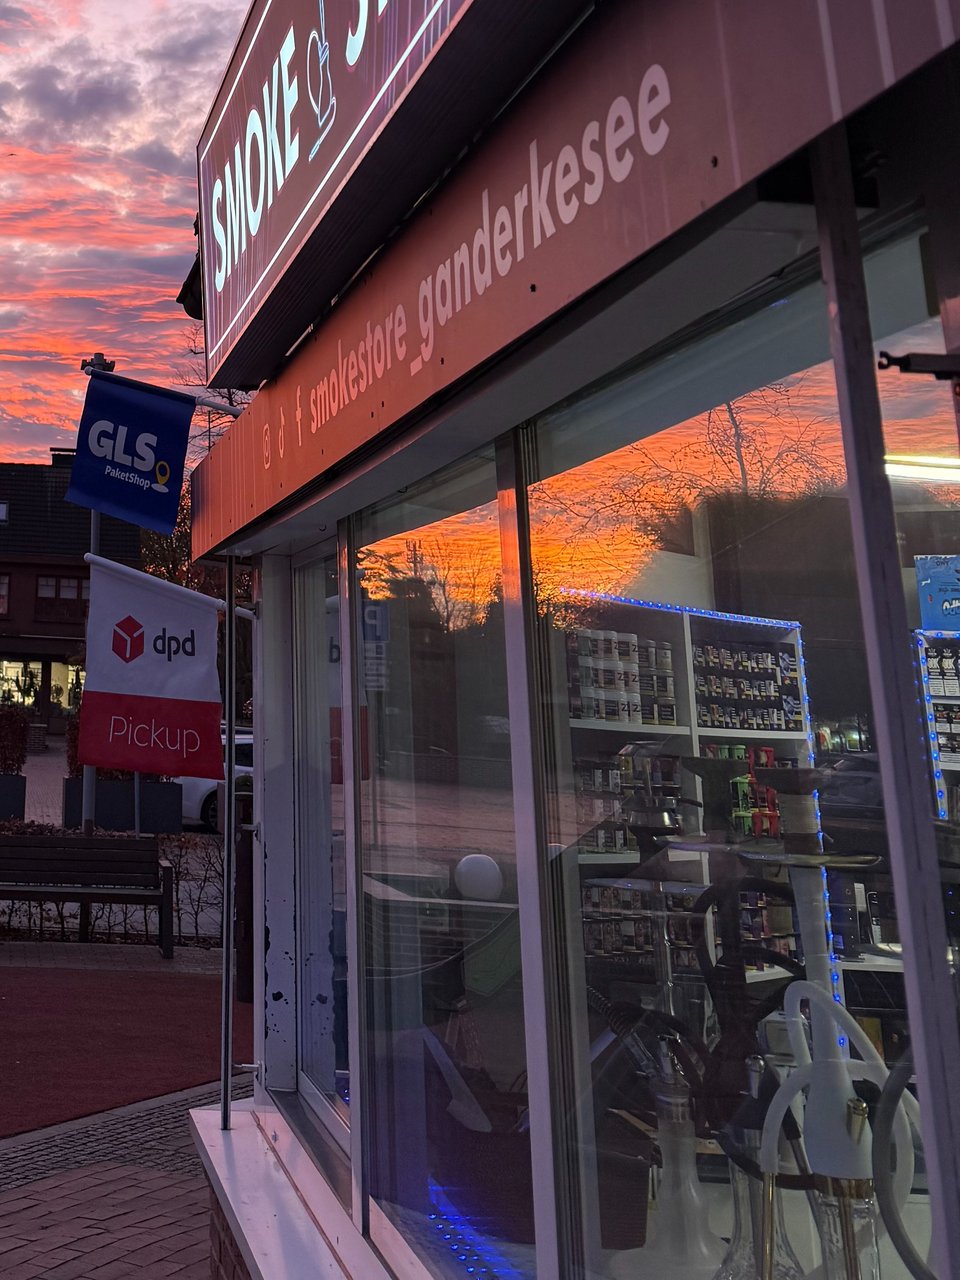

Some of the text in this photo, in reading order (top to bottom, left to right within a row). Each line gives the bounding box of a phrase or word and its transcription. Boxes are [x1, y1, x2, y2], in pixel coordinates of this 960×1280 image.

[212, 25, 299, 293] SMOKE
[310, 63, 671, 435] smokestore_ganderkesee
[88, 420, 158, 472] GLS
[104, 465, 151, 490] PaketShop
[153, 627, 195, 662] dpd
[109, 715, 201, 758] Pickup
